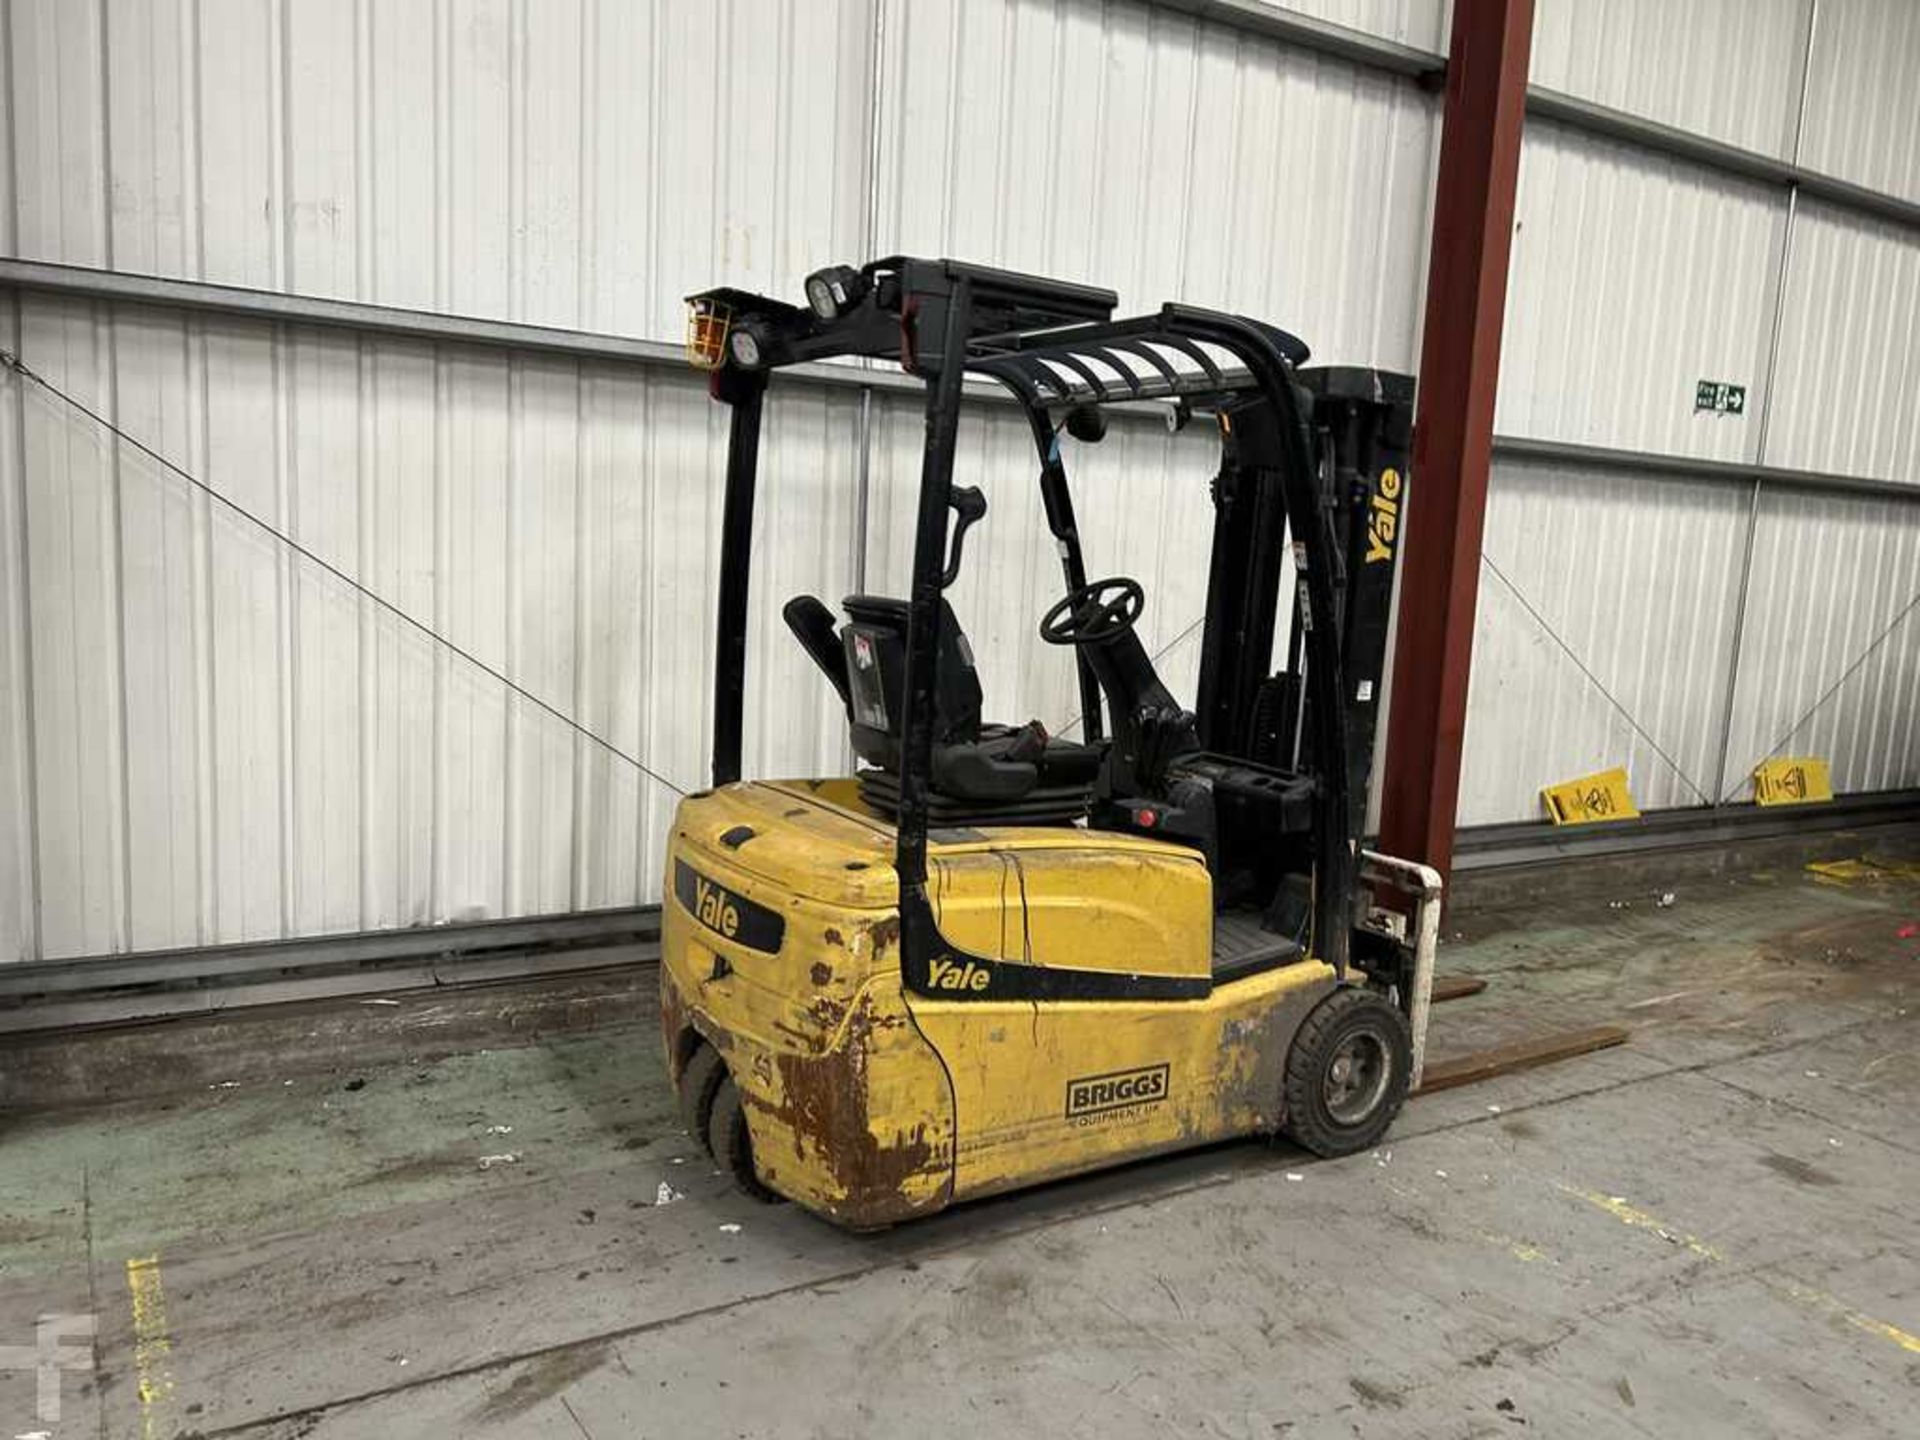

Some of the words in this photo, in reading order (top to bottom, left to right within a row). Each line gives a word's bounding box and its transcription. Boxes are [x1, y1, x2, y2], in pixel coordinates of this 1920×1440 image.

[1365, 468, 1400, 563] Yale
[694, 875, 739, 938] Yale
[926, 958, 990, 991] Yale
[1073, 1072, 1162, 1108] BRIGGS
